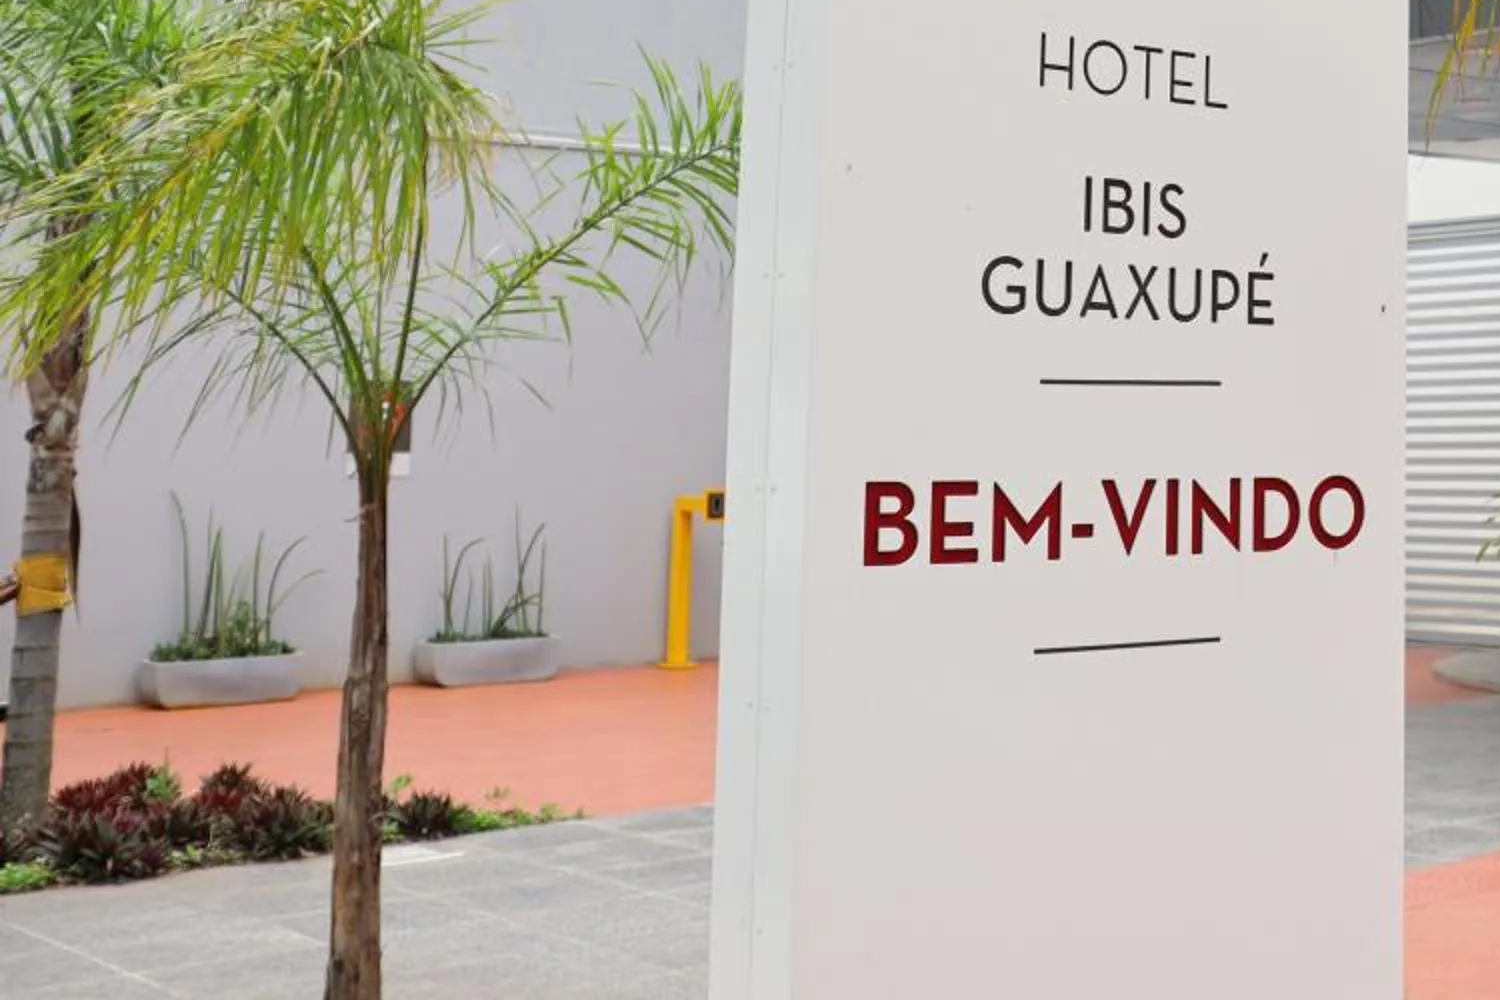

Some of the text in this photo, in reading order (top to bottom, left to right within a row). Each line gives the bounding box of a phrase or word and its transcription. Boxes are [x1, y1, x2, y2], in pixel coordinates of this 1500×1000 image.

[1039, 31, 1229, 110] HOTEL
[1083, 175, 1187, 239] IBIS
[981, 252, 1275, 326] GUAXUPÉ
[863, 474, 1366, 567] BEM-VINDO
